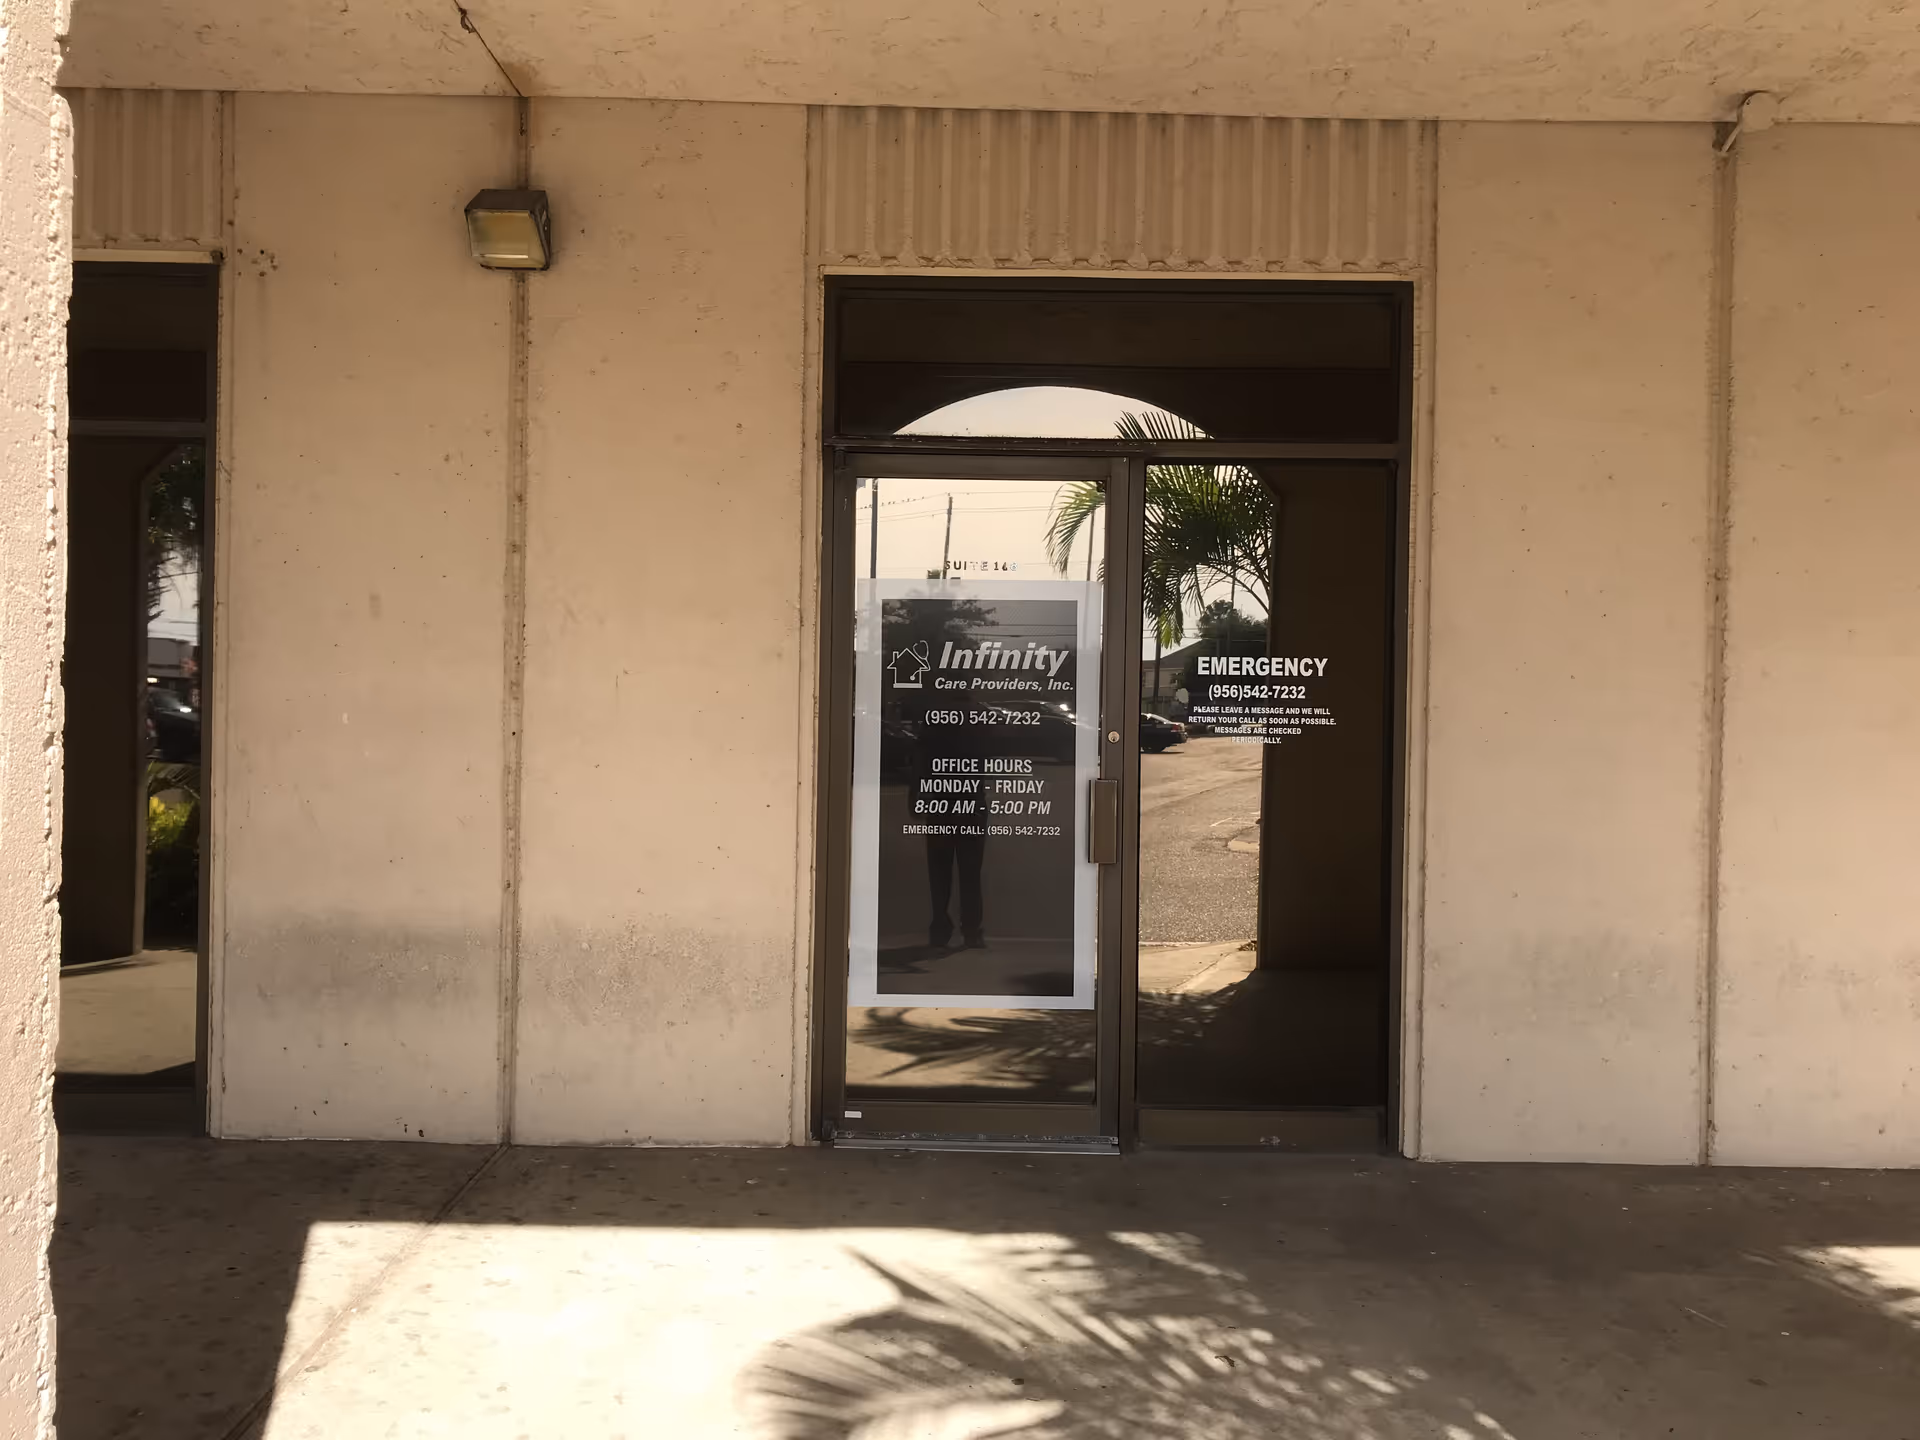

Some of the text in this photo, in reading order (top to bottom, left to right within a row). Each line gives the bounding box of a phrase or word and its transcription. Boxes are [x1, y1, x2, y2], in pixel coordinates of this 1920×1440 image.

[944, 560, 989, 571] SUITE
[938, 642, 1069, 677] Infinity
[1197, 657, 1328, 676] EMERGENCY
[934, 678, 1074, 691] Care Providers, Inc.
[1209, 685, 1306, 701] (956)542-7232
[925, 710, 1041, 726] (956) 542-7232
[1231, 736, 1282, 744] PERIODICALLY.
[932, 759, 1032, 773] OFFICE HOURS
[920, 779, 980, 793] MONDAY
[996, 780, 1044, 793] FRIDAY
[914, 800, 948, 813] 8:00
[952, 801, 975, 814] AM
[990, 801, 1023, 814] 5:00
[1028, 801, 1051, 814] PM
[903, 825, 1060, 835] EMERGENCY CALL: (956) 542-7232
